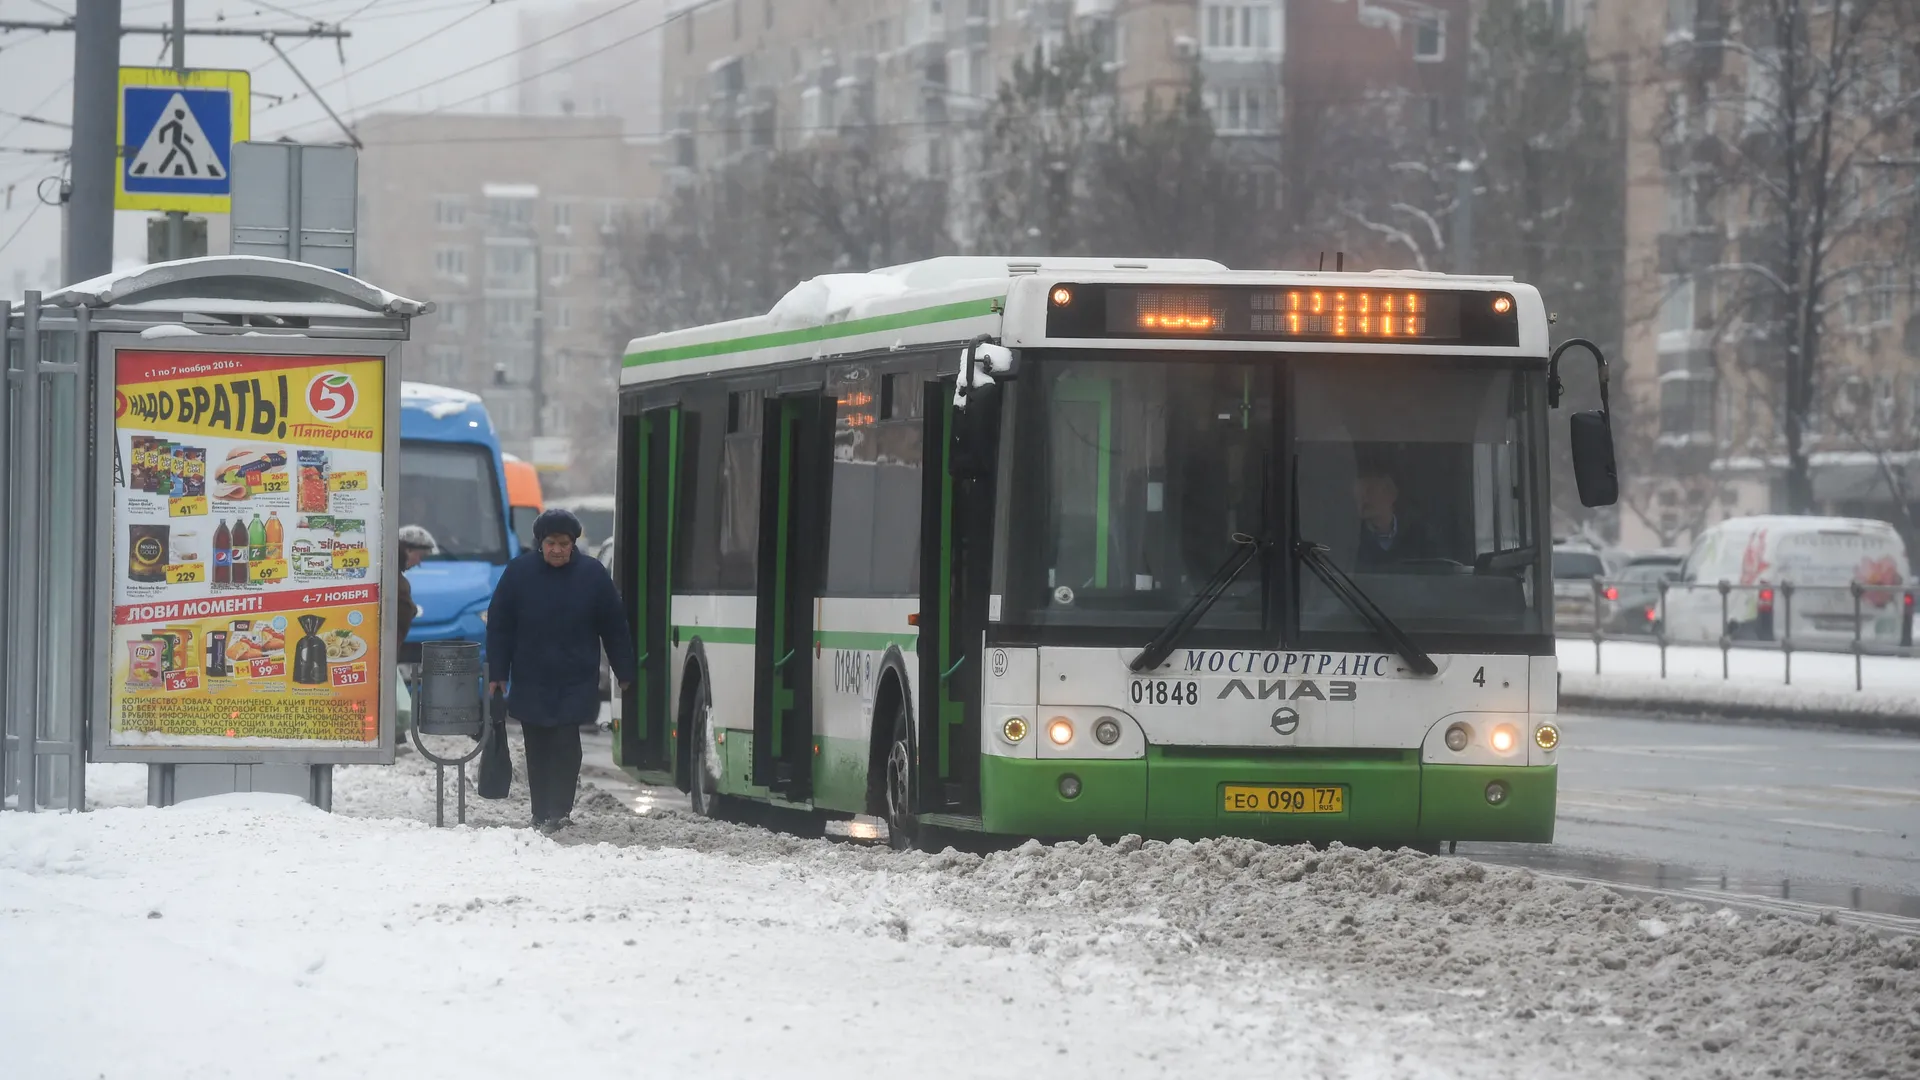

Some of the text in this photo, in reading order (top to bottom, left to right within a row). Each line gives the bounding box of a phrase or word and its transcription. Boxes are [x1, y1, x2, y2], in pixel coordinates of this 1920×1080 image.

[179, 364, 212, 374] ноября
[212, 360, 234, 370] 2016
[128, 374, 288, 440] НАДО БРАТЬ!
[247, 474, 260, 482] 1+1
[339, 480, 358, 490] 239
[342, 558, 360, 567] 259
[176, 572, 195, 582] 229
[324, 590, 369, 601] НОЯБРЯ
[127, 597, 263, 622] ЛОВИ МОМЕНТ!
[235, 666, 250, 674] 1+1
[1184, 650, 1391, 678] МОСГОРТРАНС
[341, 673, 359, 683] 319
[834, 650, 861, 695] 01848
[1472, 666, 1486, 688] 4
[1130, 680, 1199, 706] 01848
[1216, 678, 1358, 702] ЛИАЗ
[202, 720, 266, 728] УЧАСТВУЮЩИХ
[1267, 790, 1306, 810] 090
[1315, 788, 1336, 805] 77
